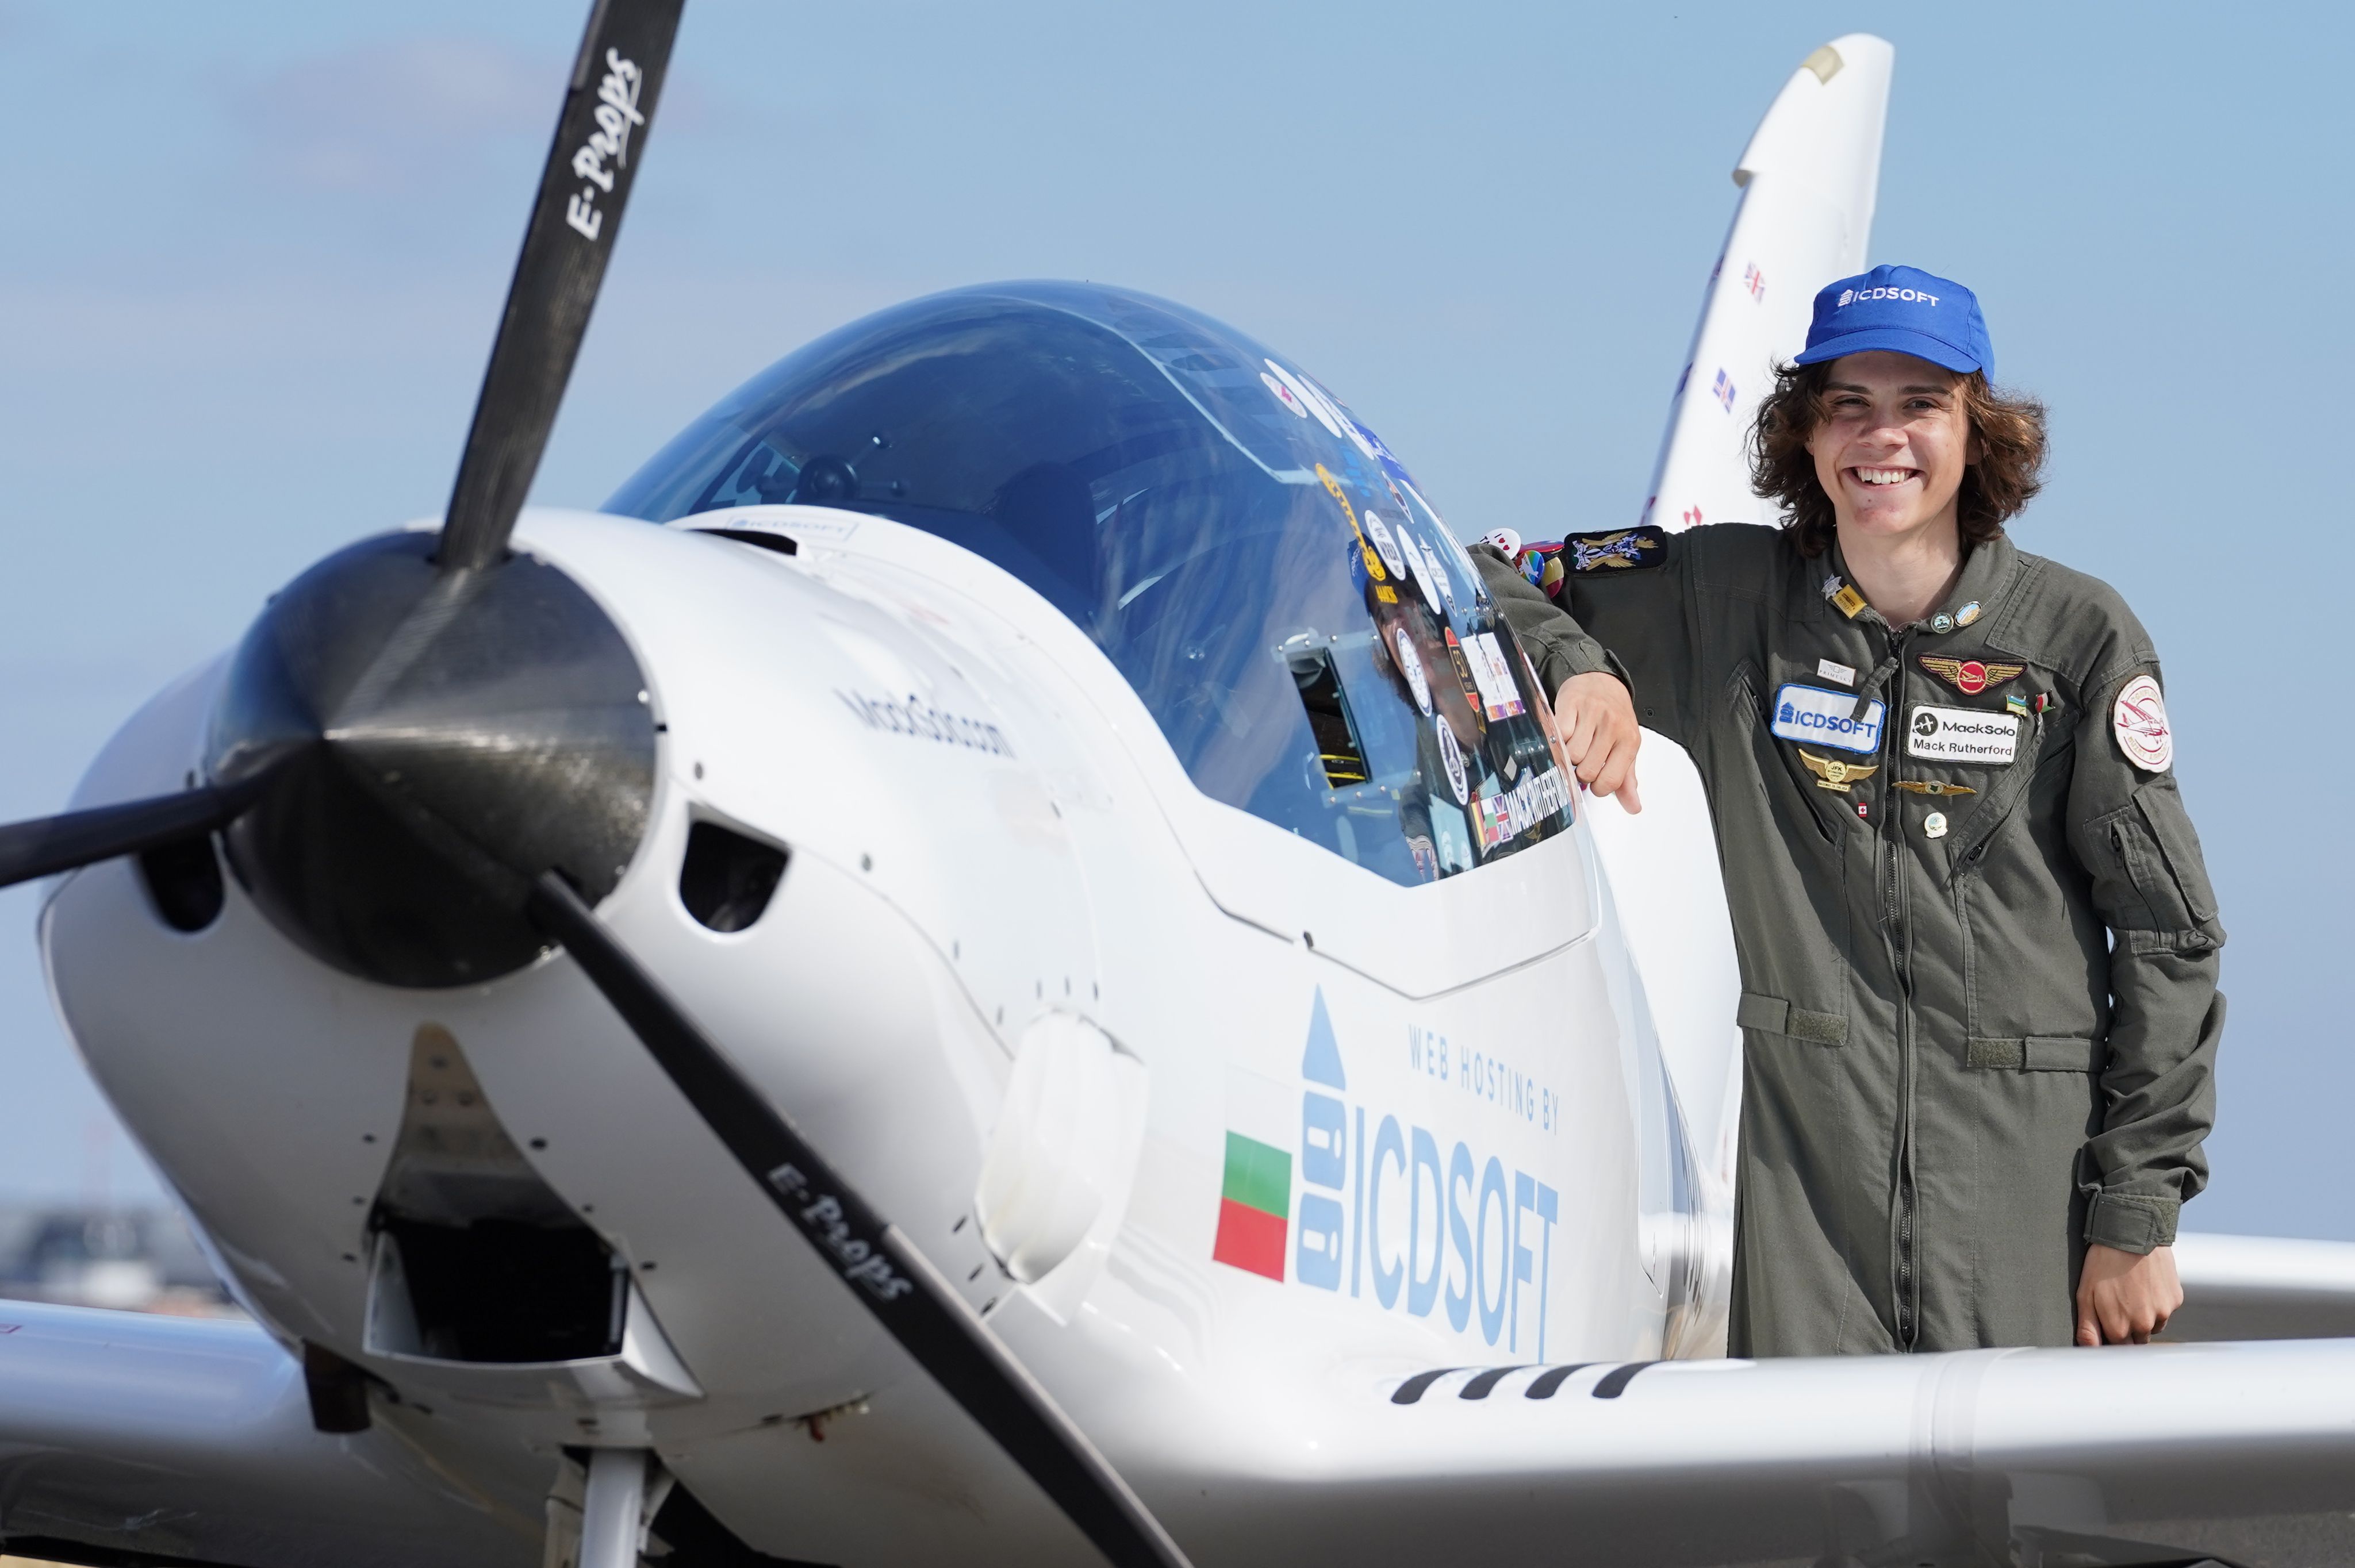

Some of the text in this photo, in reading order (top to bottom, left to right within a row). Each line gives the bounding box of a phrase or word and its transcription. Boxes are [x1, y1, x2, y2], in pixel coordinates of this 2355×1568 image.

[1852, 287, 1939, 306] ICDSOFT
[1819, 670, 1851, 682] PRIMESKY
[1794, 711, 1876, 737] ICDSOFT
[1943, 721, 2015, 736] MackSolo
[1914, 739, 2012, 756] Mack Rutherford
[1504, 783, 1535, 835] MACK
[1409, 1024, 1558, 1135] WEB HOSTING BY
[1351, 1106, 1558, 1365] ICDSOFT
